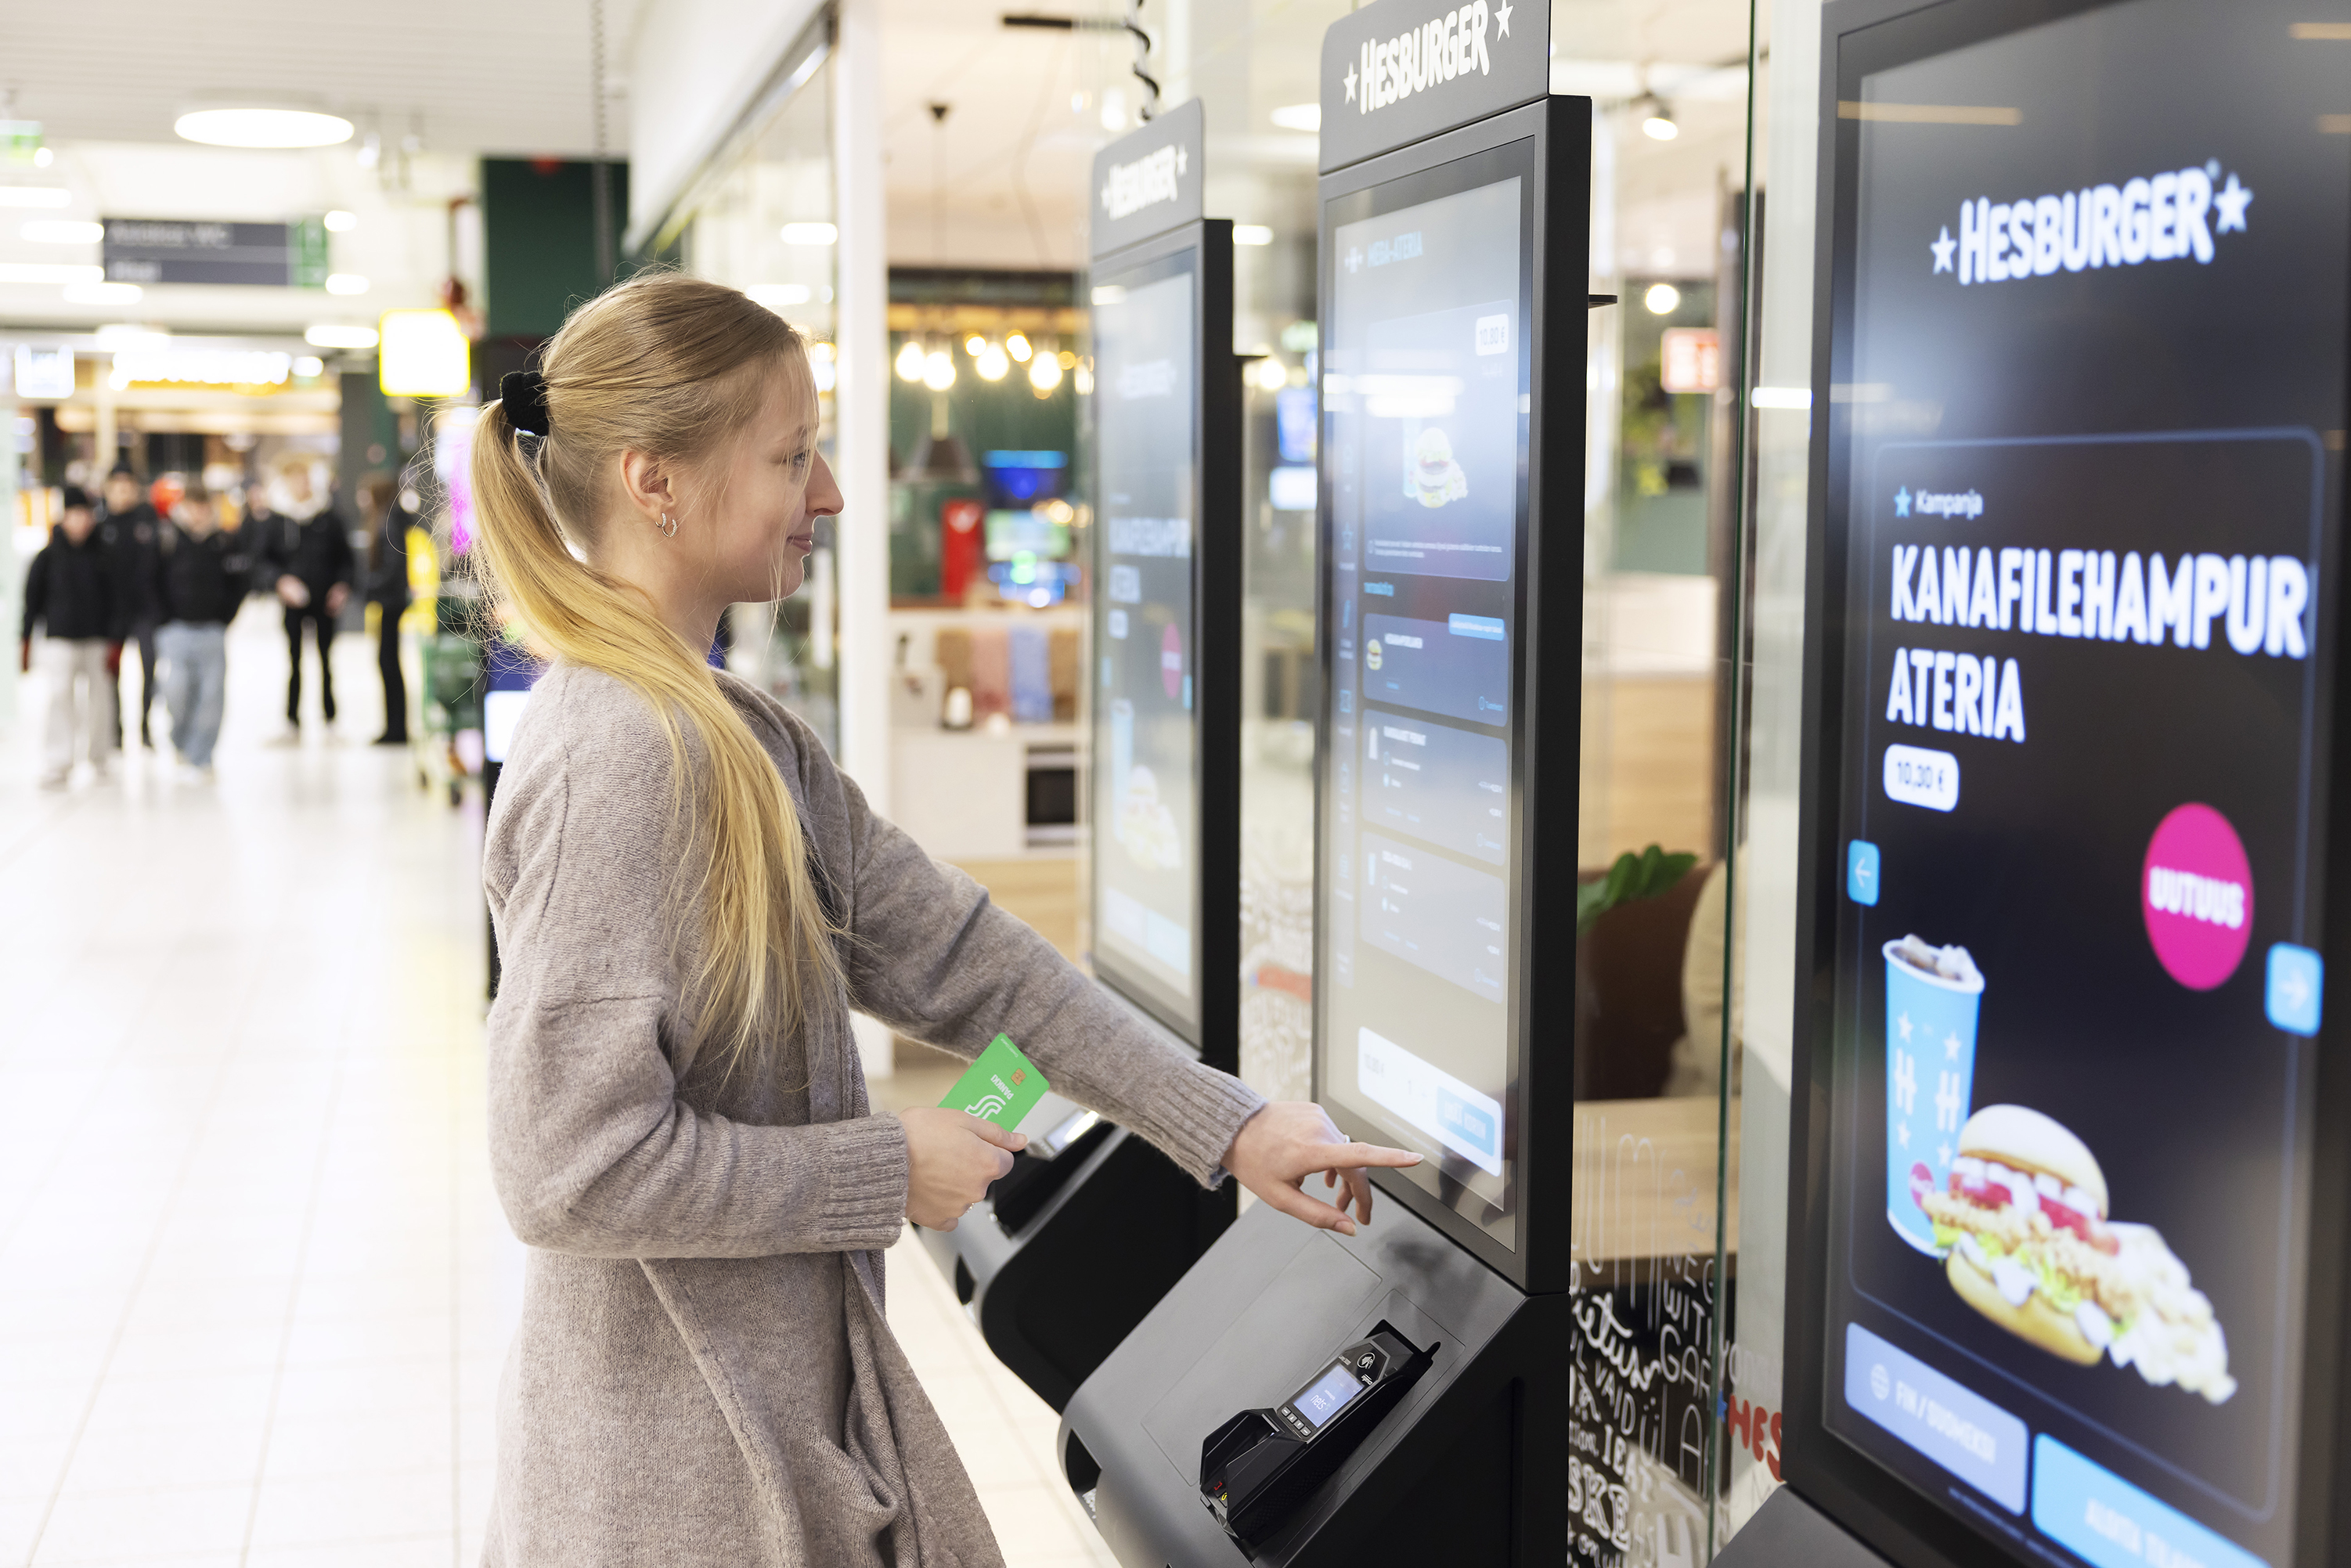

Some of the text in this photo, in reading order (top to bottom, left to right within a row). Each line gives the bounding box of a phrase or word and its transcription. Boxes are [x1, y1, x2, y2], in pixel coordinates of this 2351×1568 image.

[1360, 0, 1491, 115] HESBURGER
[1958, 166, 2215, 286] HESBURGER
[1915, 488, 1983, 520] Kampanja
[1885, 647, 2026, 744] ATERIA
[2149, 865, 2245, 930] UUTUUS
[990, 1073, 1015, 1100] PANKKI
[1310, 1393, 1327, 1411] nets
